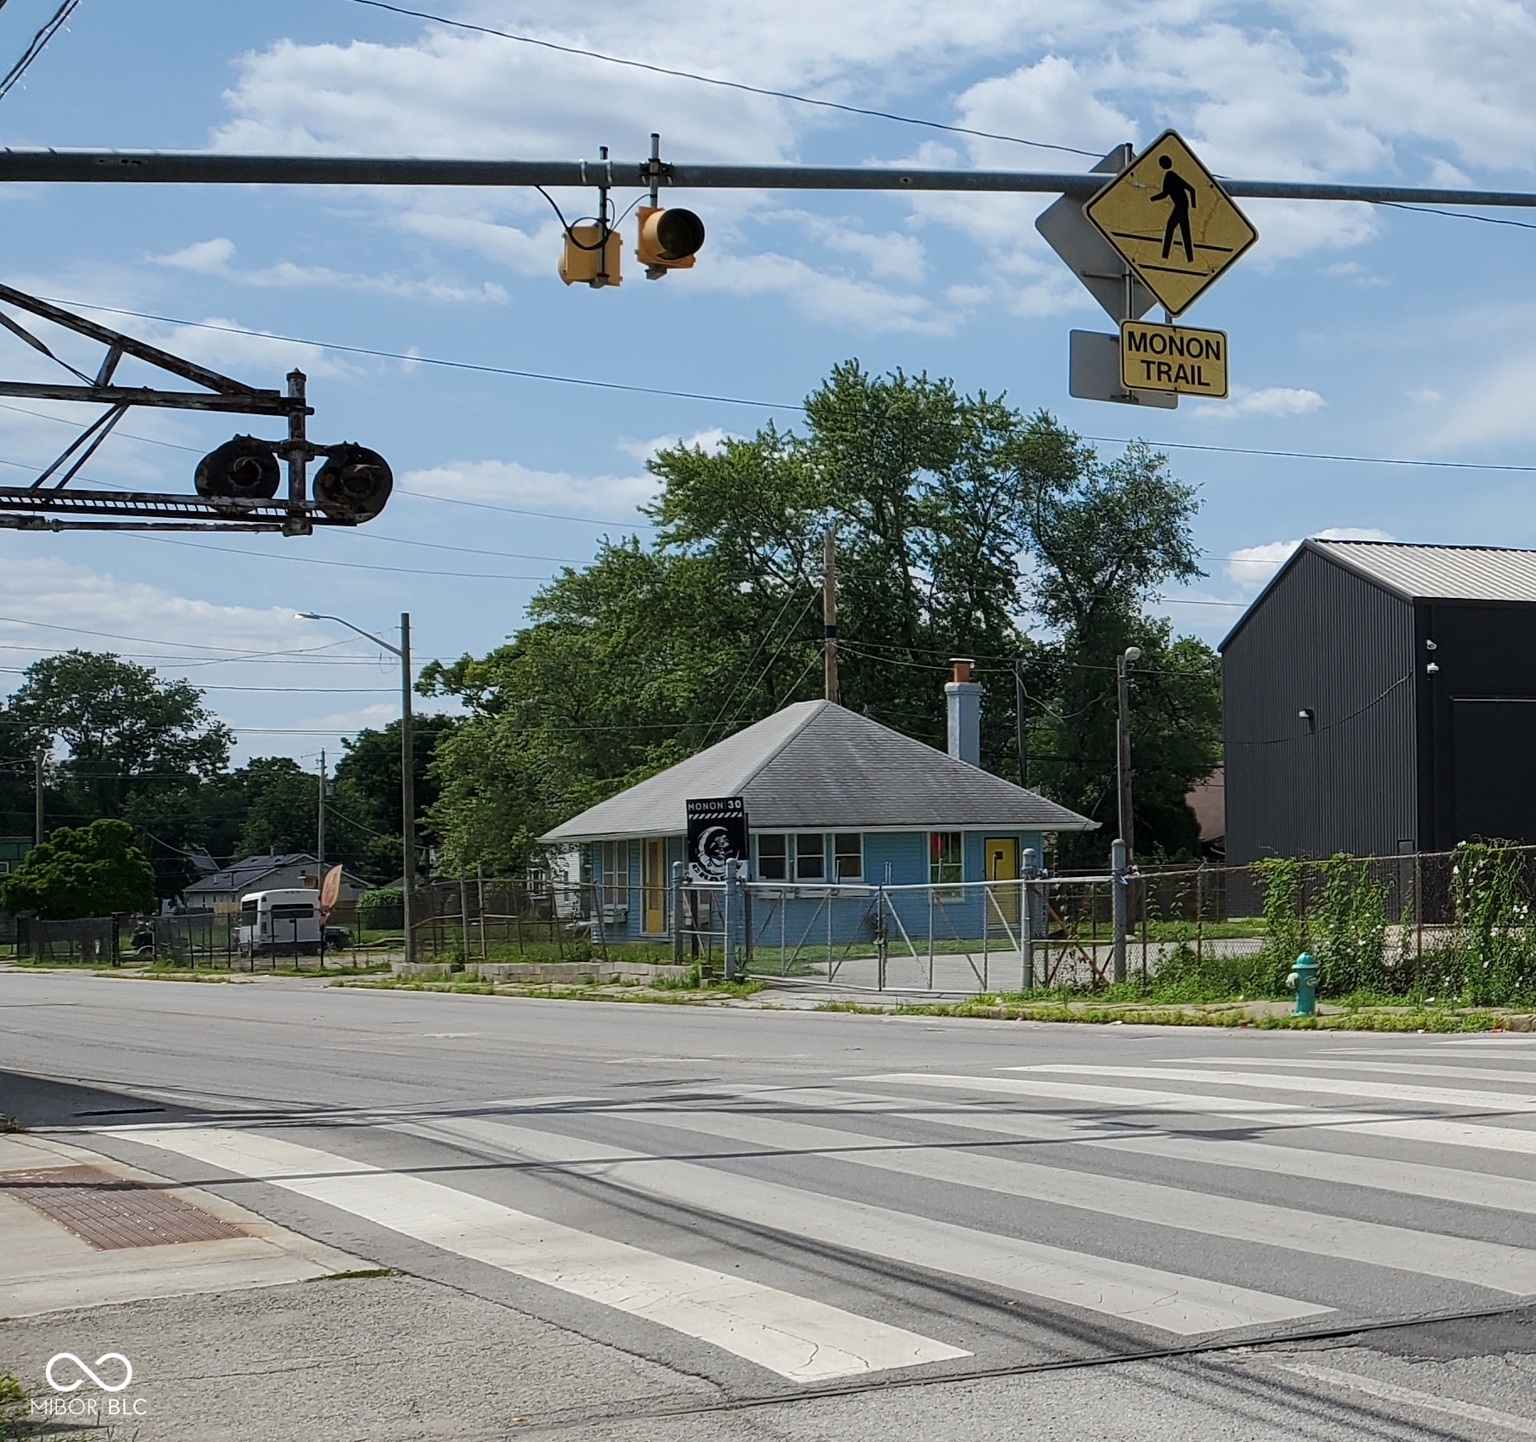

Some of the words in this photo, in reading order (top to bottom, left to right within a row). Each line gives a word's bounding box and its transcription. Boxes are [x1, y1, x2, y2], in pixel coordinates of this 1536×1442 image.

[1127, 331, 1221, 361] MONON
[1140, 359, 1211, 387] TRAIL
[688, 801, 724, 811] MONON
[727, 800, 742, 809] 30
